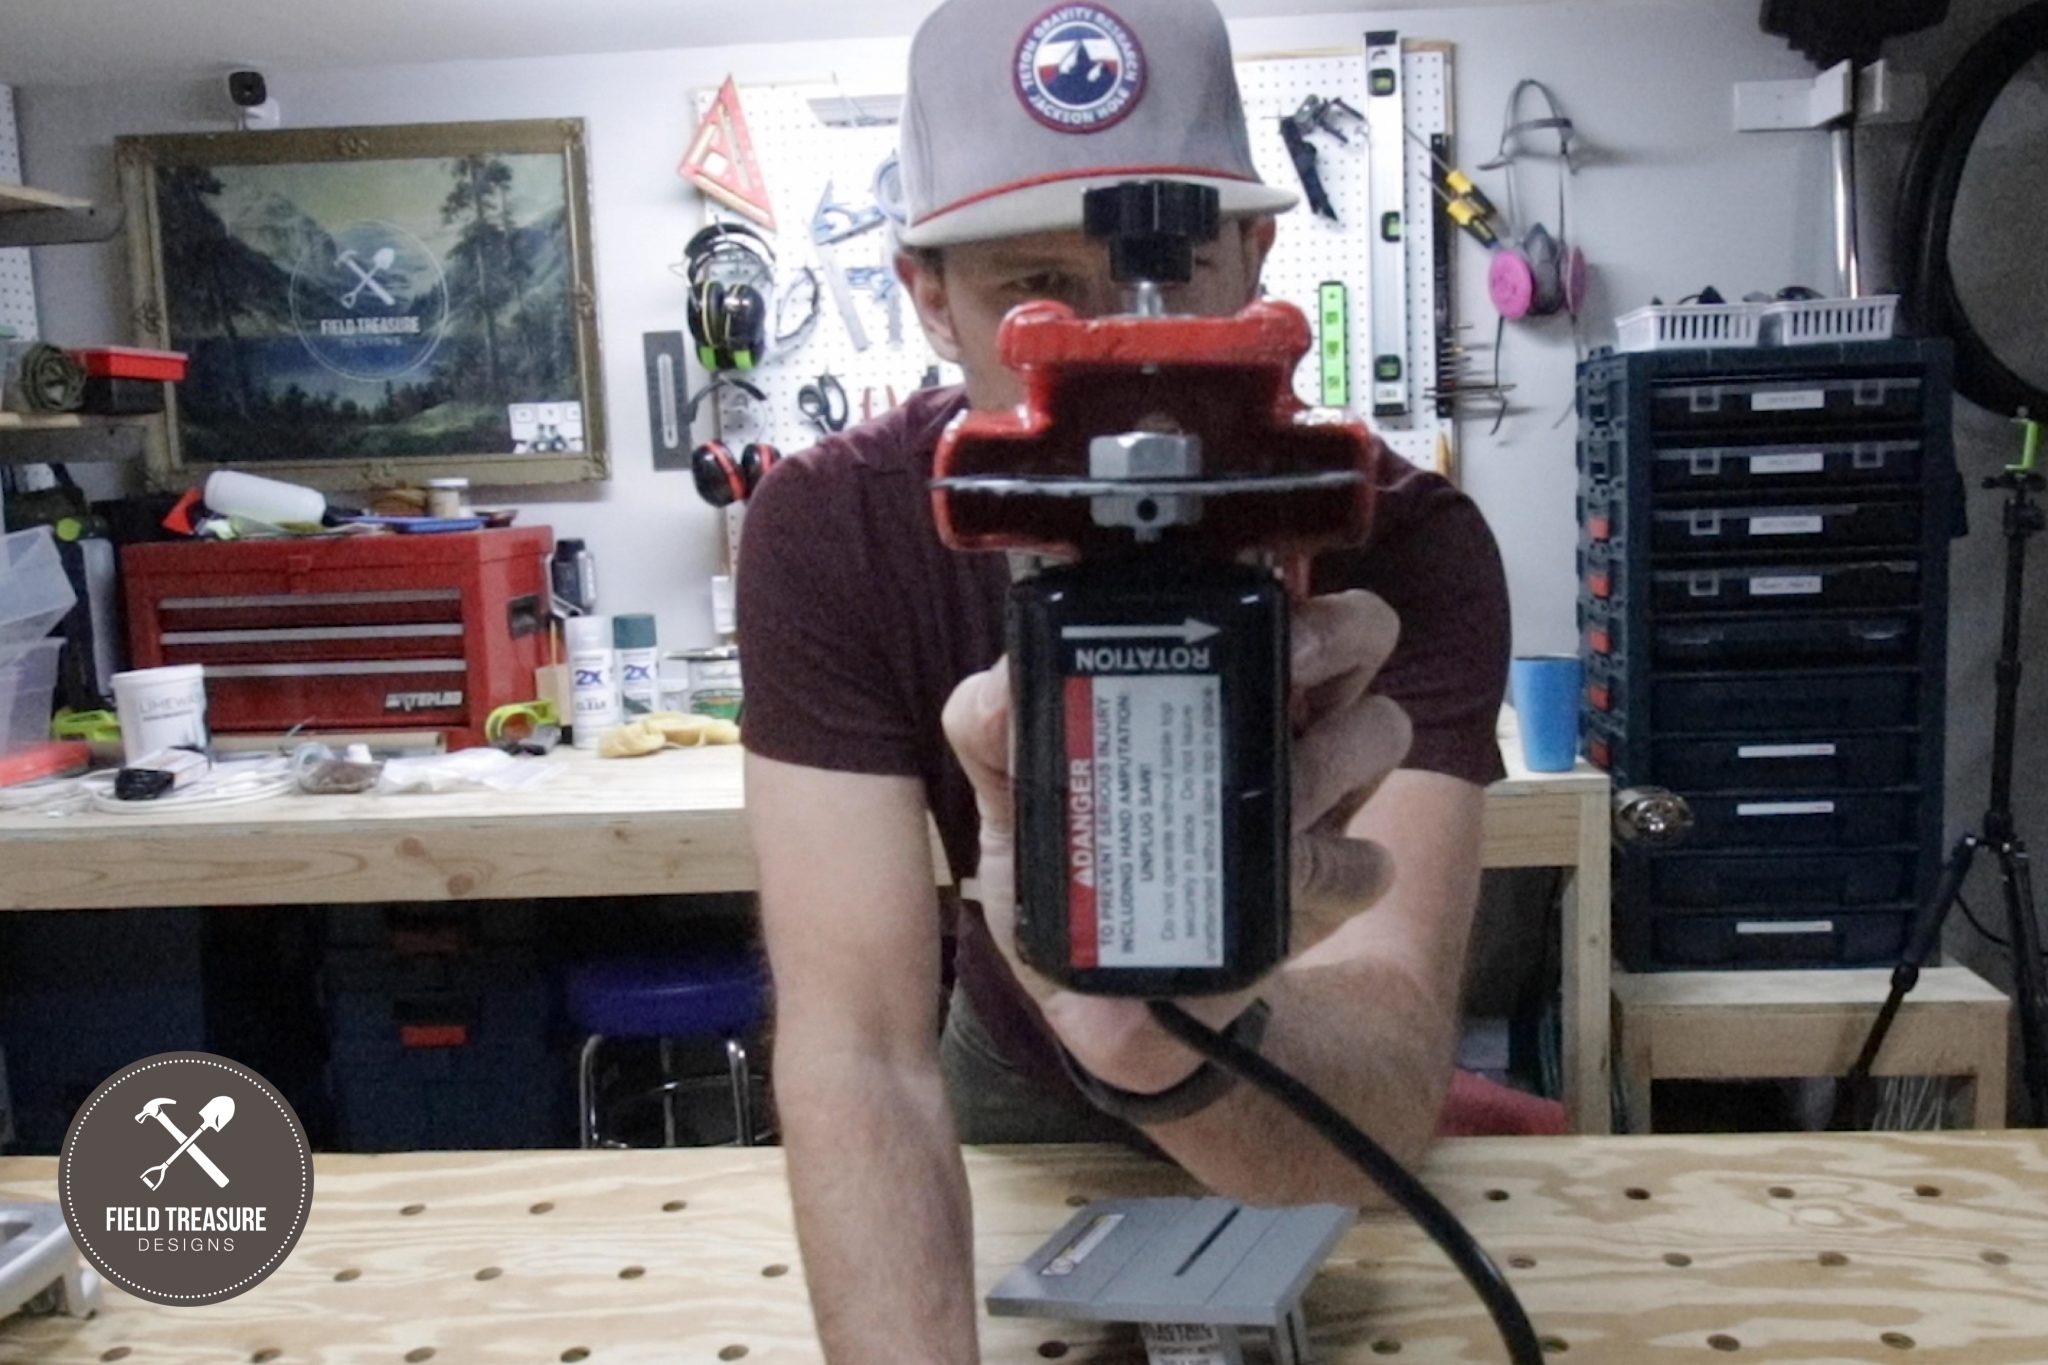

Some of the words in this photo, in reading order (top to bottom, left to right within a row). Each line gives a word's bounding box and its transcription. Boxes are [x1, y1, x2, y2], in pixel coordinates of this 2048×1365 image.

[1033, 7, 1094, 38] GRAVITY
[1094, 12, 1138, 82] RESEARCH
[1028, 94, 1095, 124] JACKSON
[1097, 87, 1130, 119] HOLE
[320, 318, 355, 335] FIELD
[357, 316, 420, 334] TREASURE
[575, 669, 603, 686] 2X
[624, 664, 651, 681] 2X
[1076, 647, 1210, 670] ROTATION
[1097, 696, 1111, 758] INJURY
[1070, 758, 1094, 867] DANGER
[1098, 763, 1112, 837] SERIOUS
[1118, 809, 1132, 857] HAND
[1139, 812, 1153, 882] UNPLUG
[1099, 841, 1114, 920] PREVENT
[1119, 862, 1134, 954] INCLUDING
[1101, 924, 1114, 946] TO
